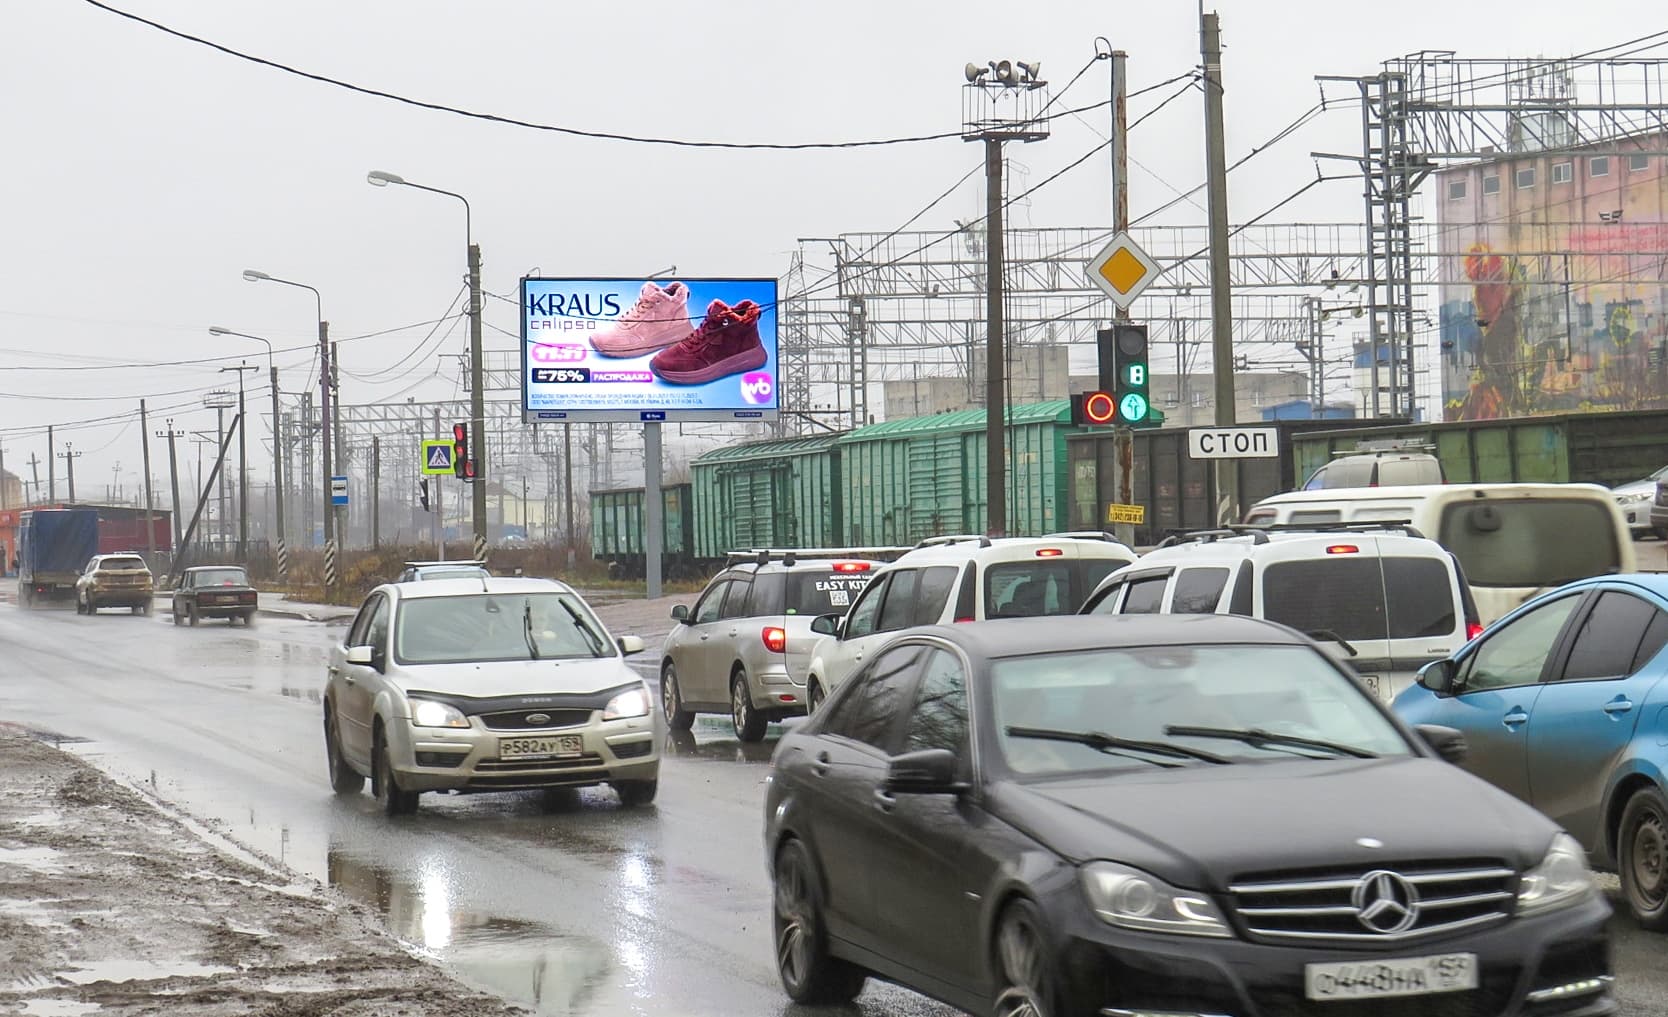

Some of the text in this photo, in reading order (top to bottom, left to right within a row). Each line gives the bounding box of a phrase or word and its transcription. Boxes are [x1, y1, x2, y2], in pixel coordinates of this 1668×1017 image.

[530, 293, 621, 317] KRAUS
[593, 373, 650, 381] РАСПРОДАЖА
[1200, 433, 1268, 454] СТОП
[816, 581, 845, 591] EASY
